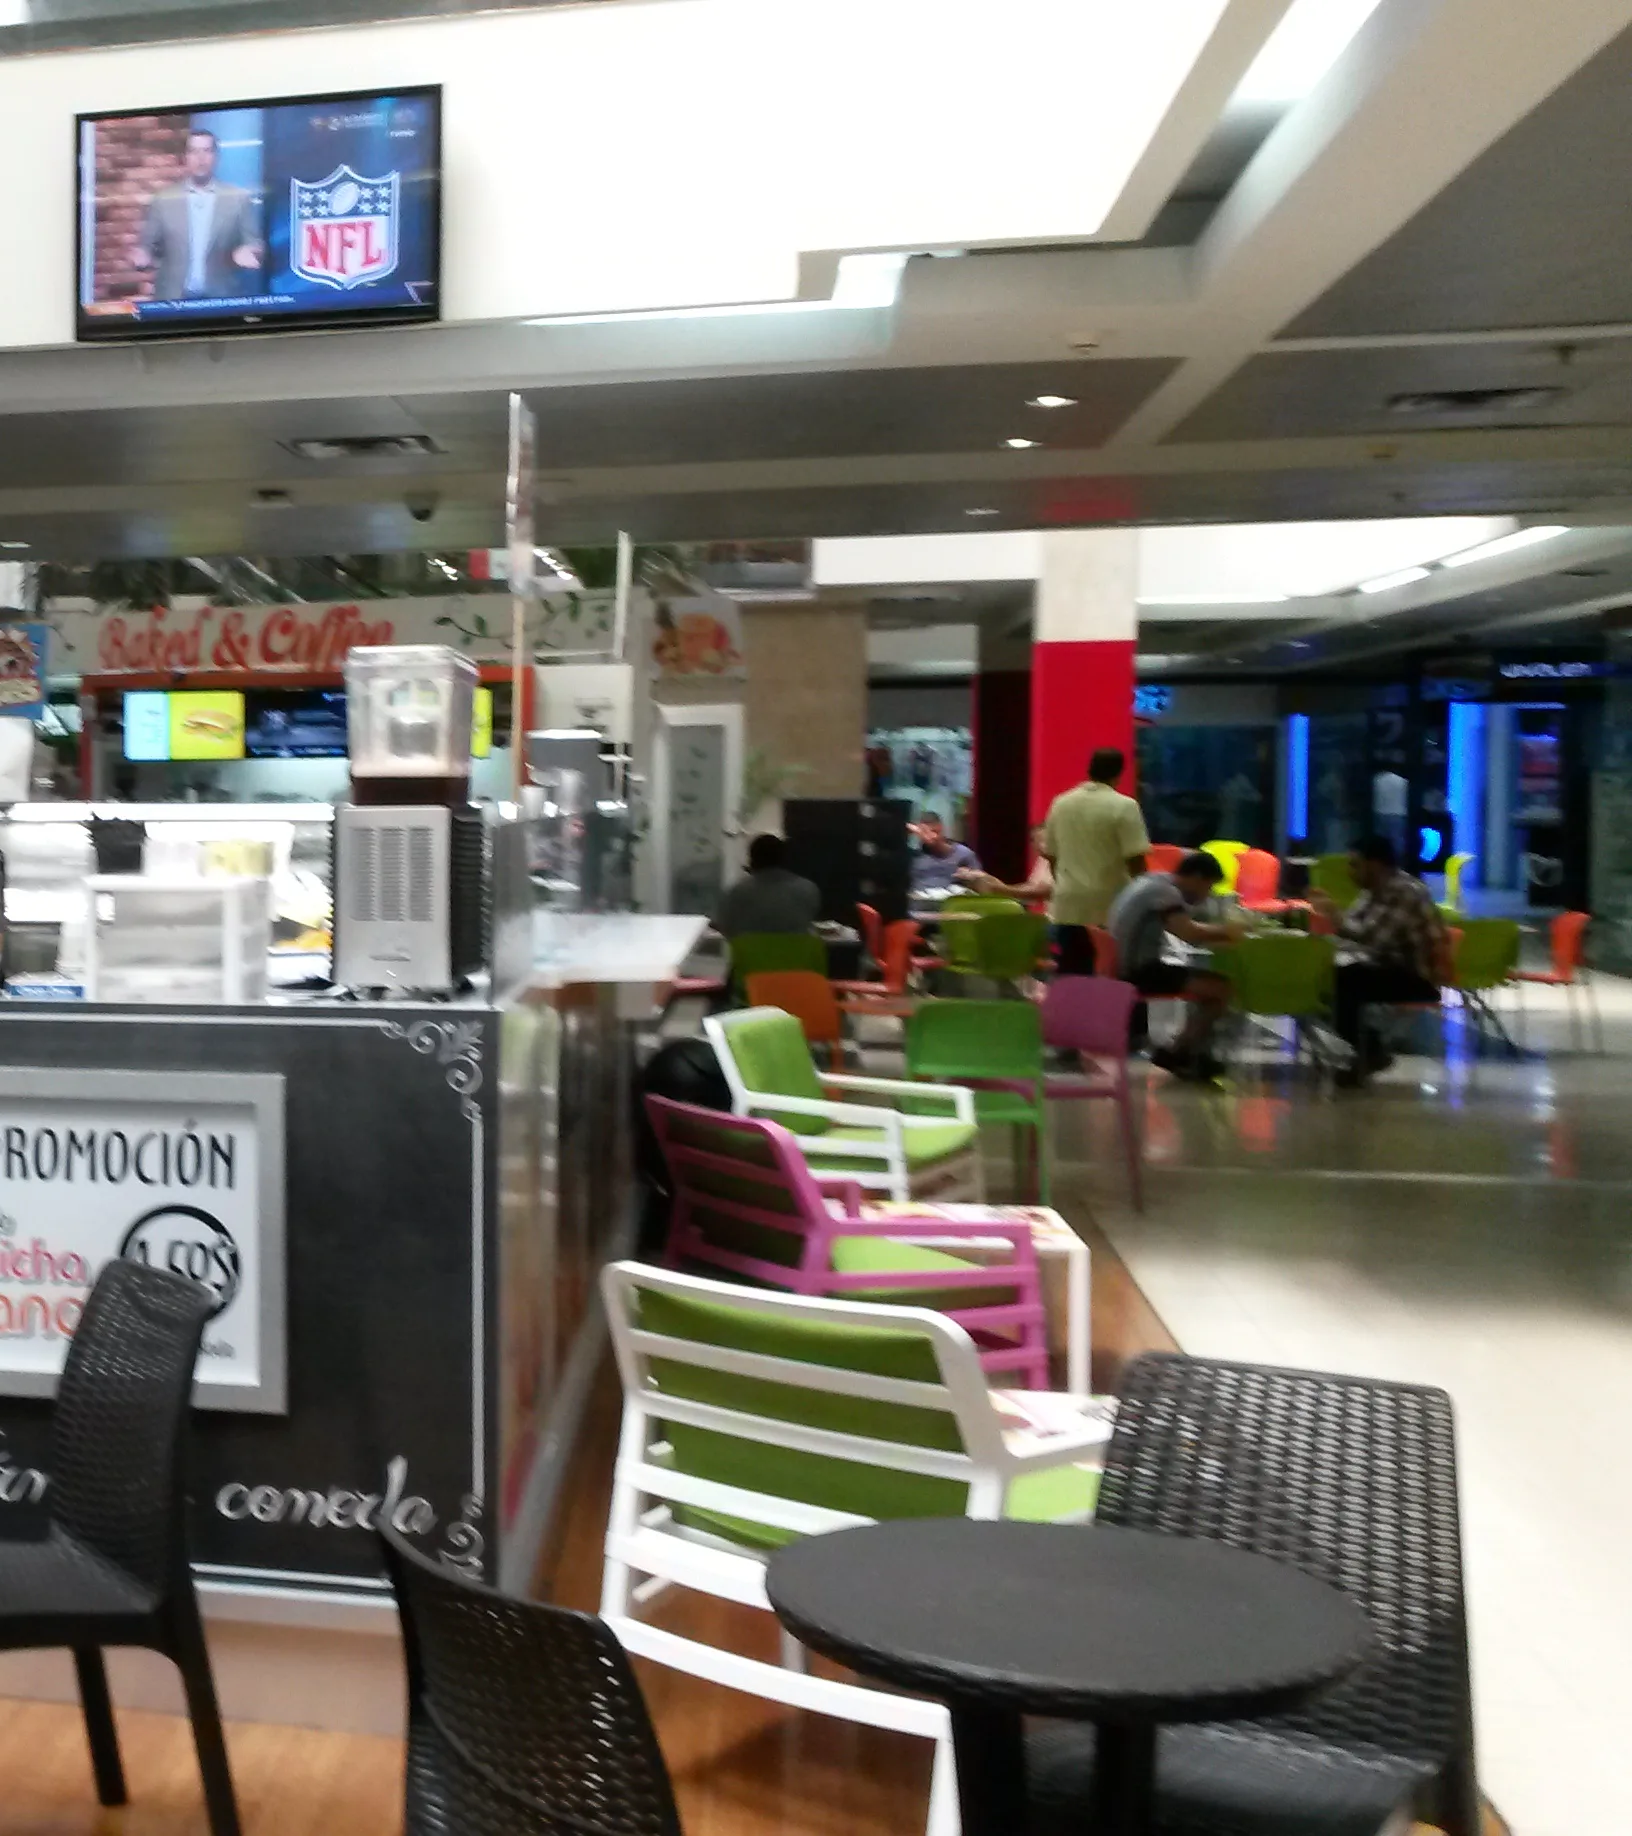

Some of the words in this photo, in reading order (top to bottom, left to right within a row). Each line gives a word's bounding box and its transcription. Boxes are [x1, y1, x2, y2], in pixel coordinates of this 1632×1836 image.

[304, 220, 383, 276] NFL
[212, 611, 250, 671] &
[215, 1453, 438, 1535] comerla
